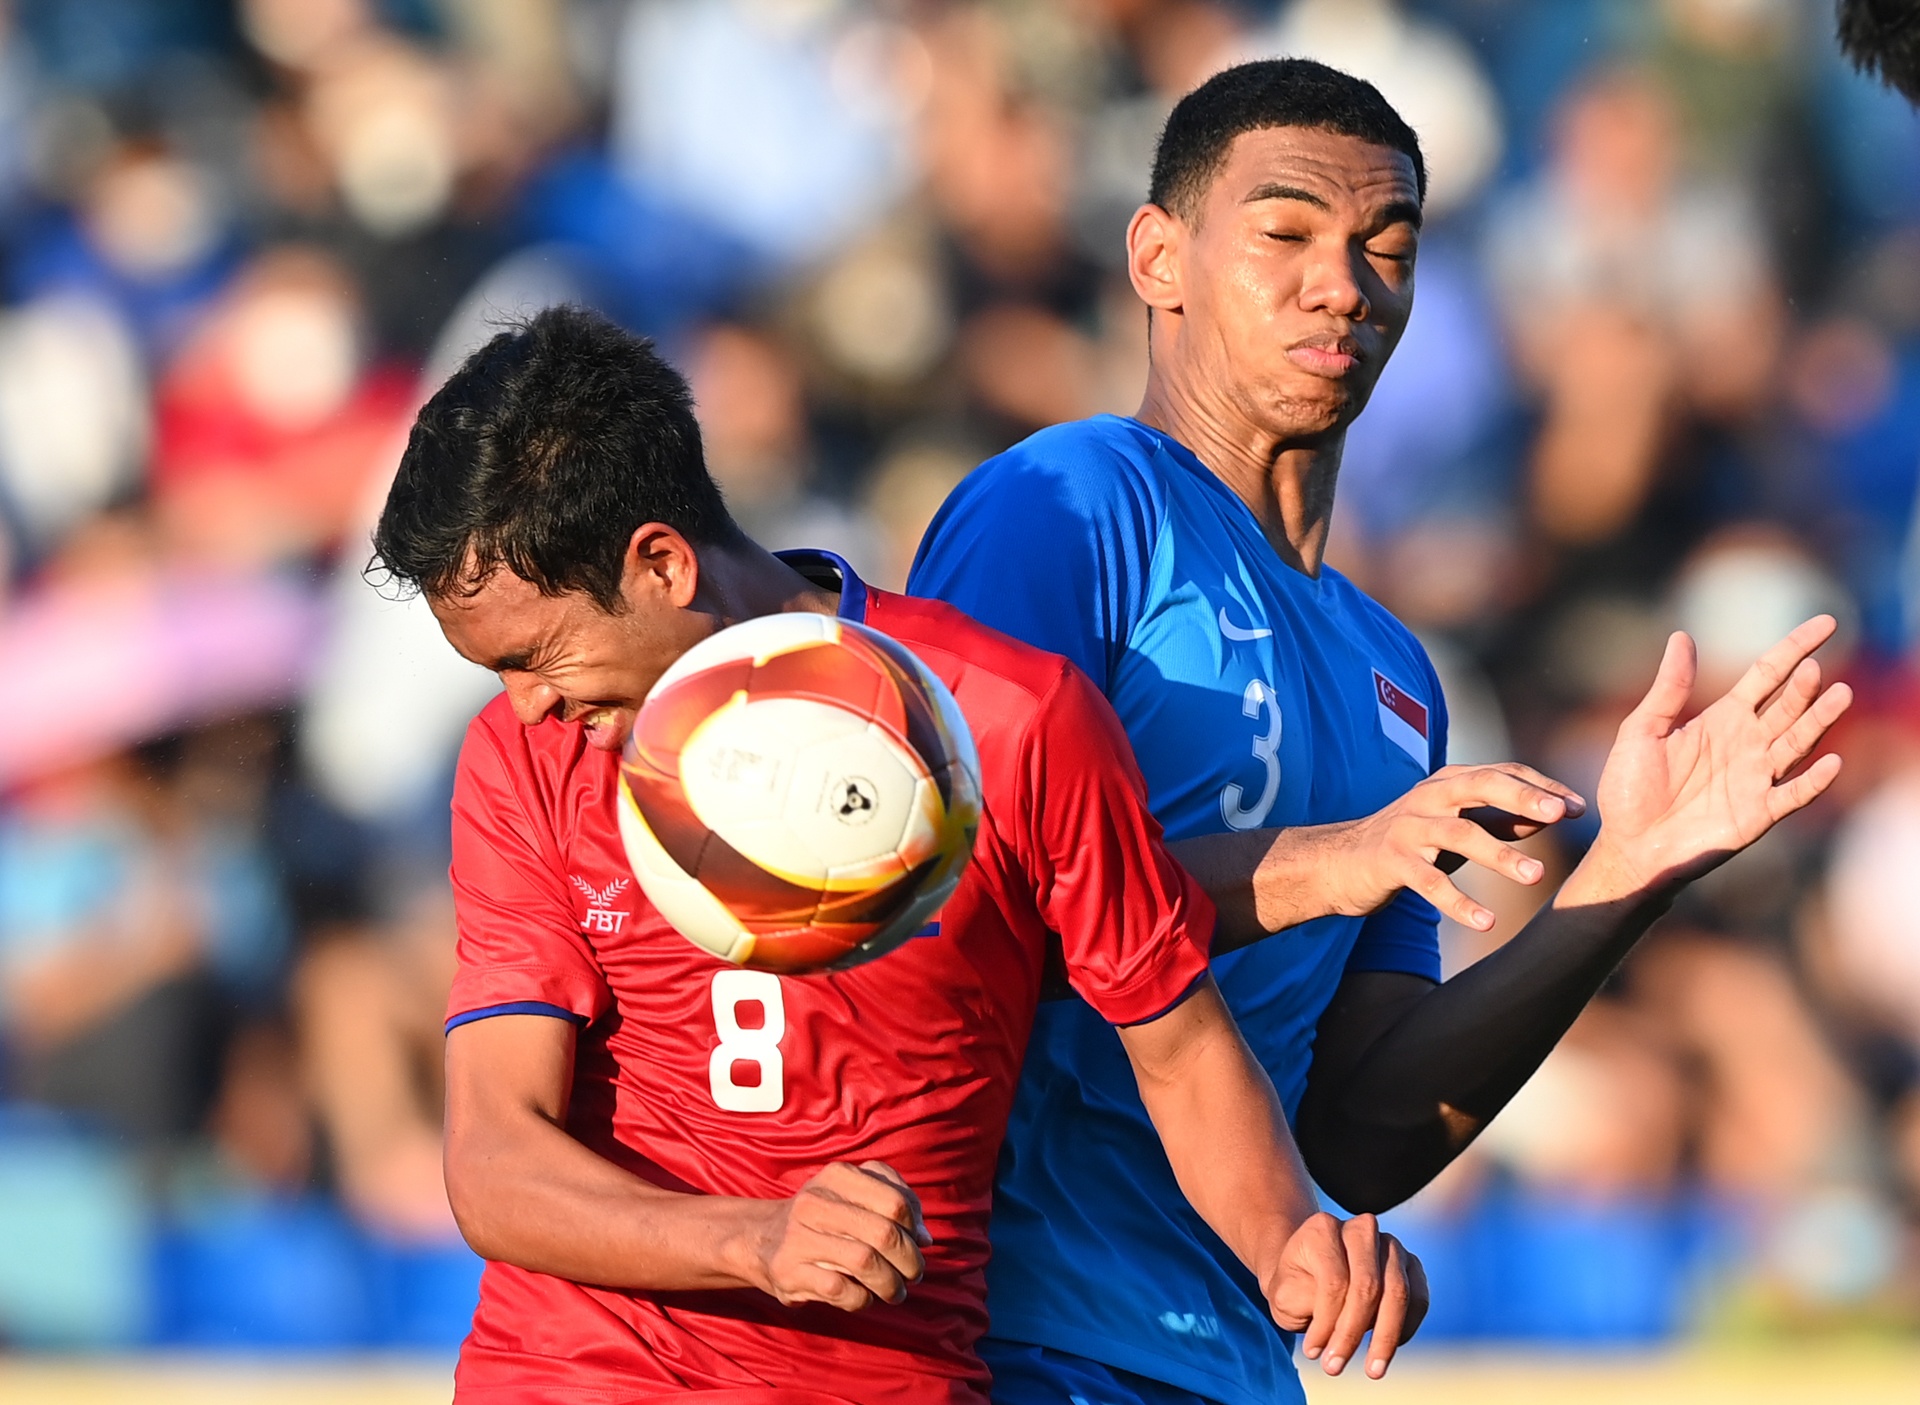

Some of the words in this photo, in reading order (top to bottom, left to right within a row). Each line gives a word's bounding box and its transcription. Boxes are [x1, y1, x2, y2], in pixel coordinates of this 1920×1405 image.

[1219, 678, 1283, 832] 3
[580, 908, 630, 934] FBT
[709, 969, 786, 1113] 8
